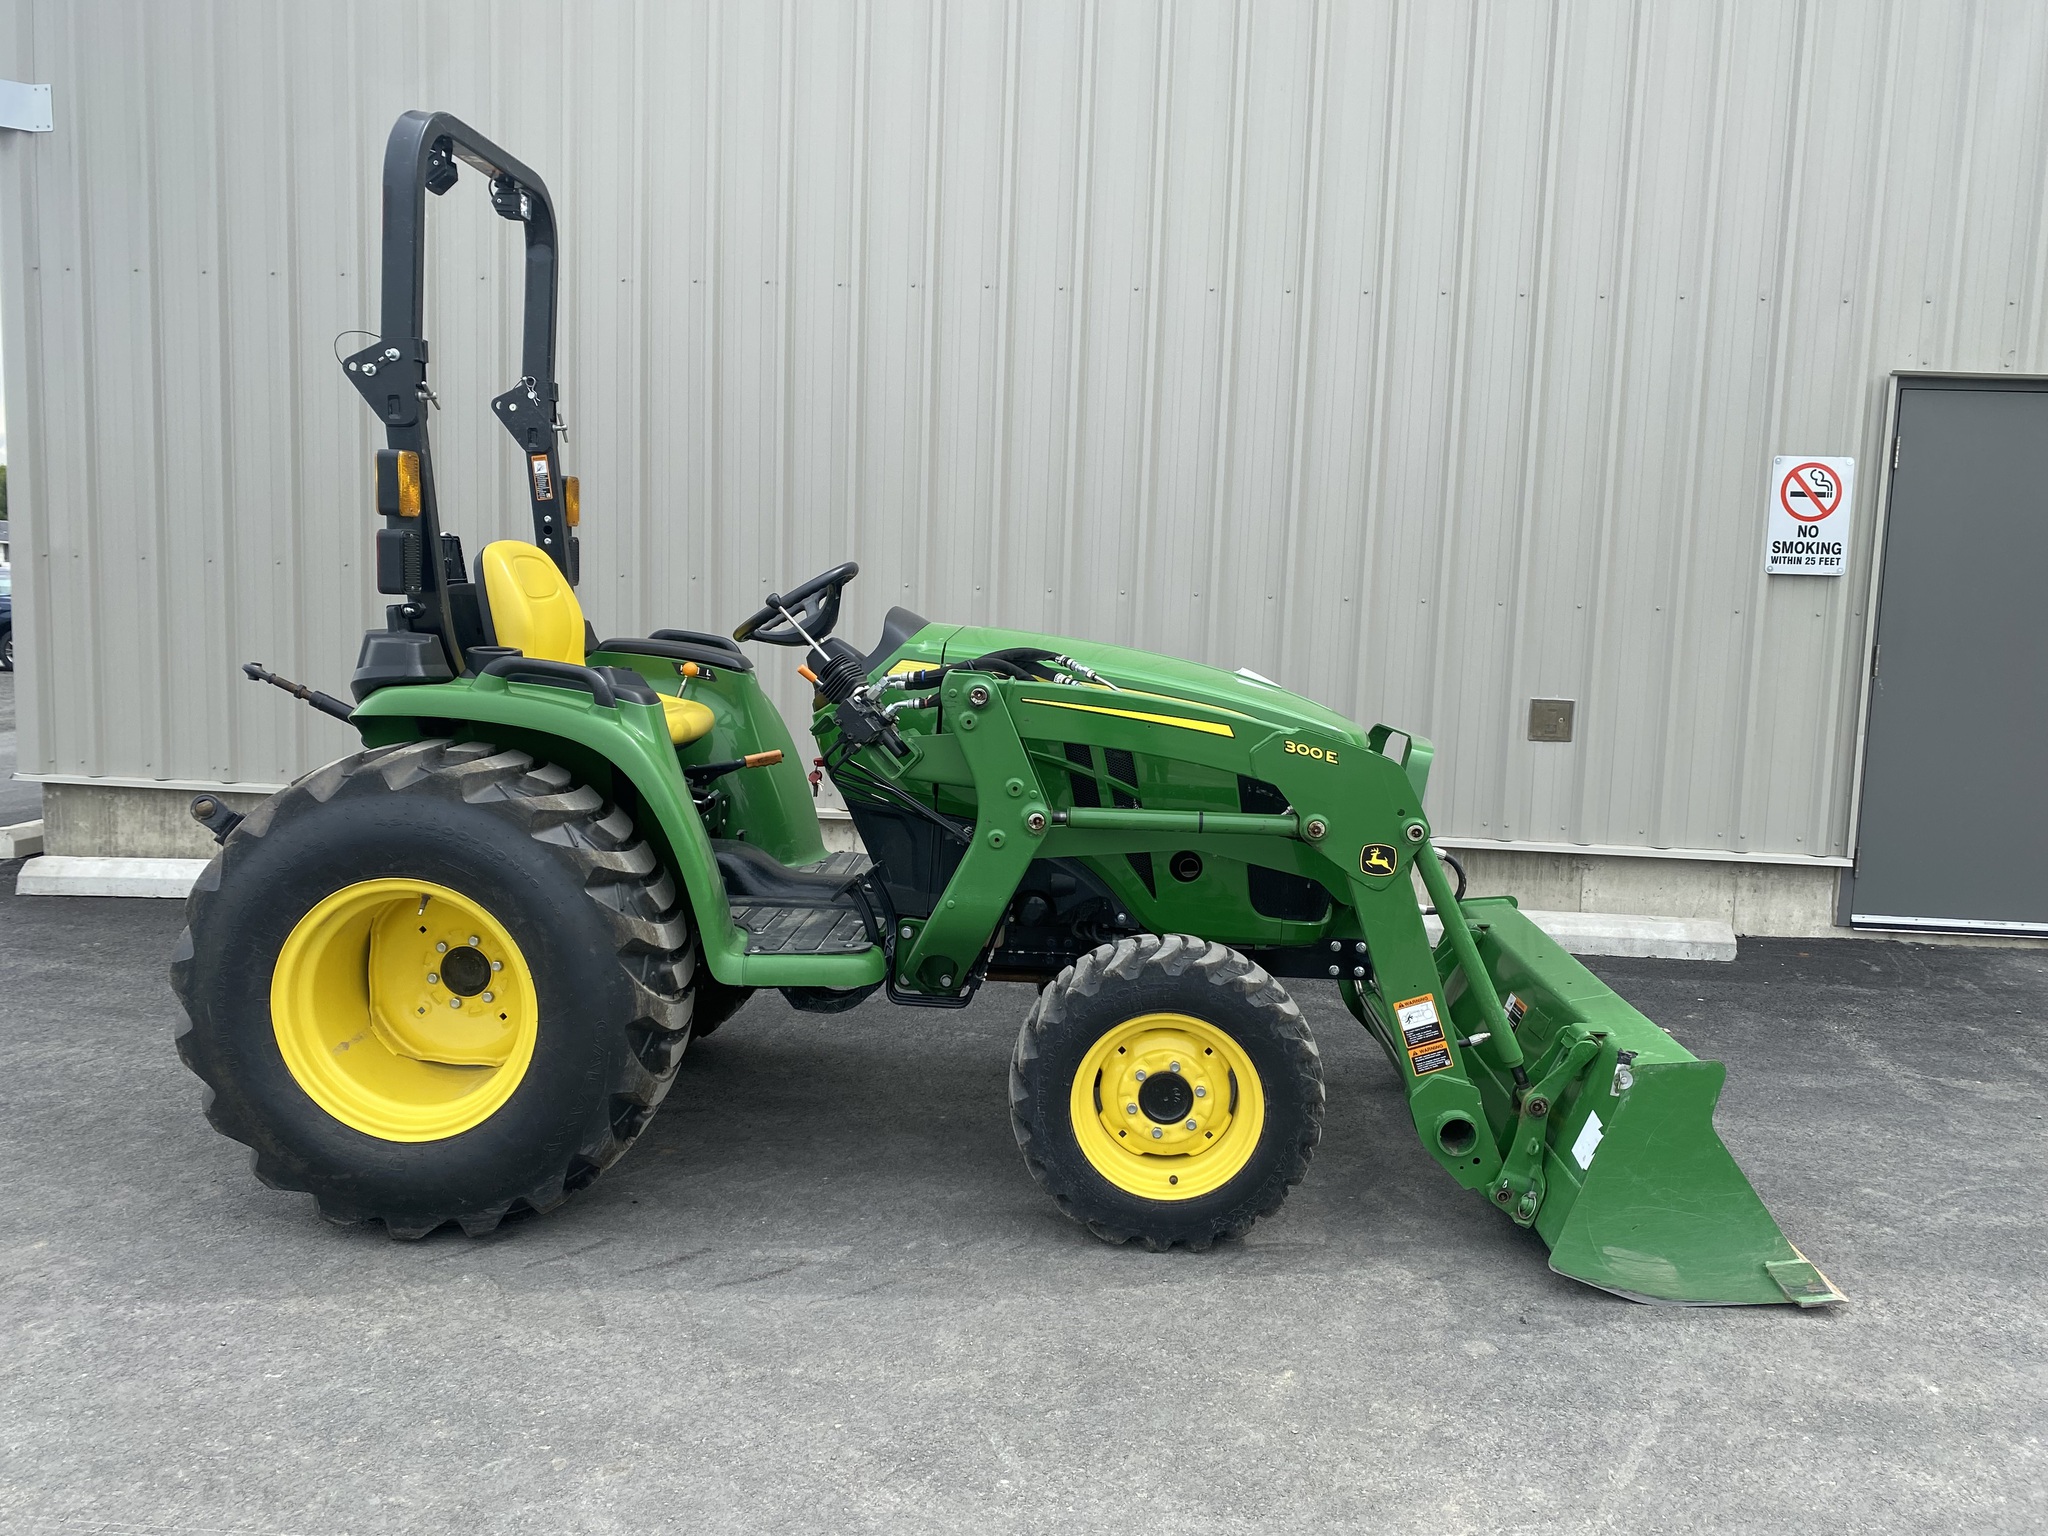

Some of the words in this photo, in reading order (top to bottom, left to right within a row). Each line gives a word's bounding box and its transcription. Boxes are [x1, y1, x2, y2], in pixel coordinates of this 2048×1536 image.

[1797, 525, 1819, 538] NO
[1772, 541, 1842, 555] SMOKING
[1770, 556, 1802, 565] WITHIN
[1805, 557, 1816, 565] 25
[1819, 557, 1841, 566] FEET
[1404, 995, 1429, 1007] WARNING
[1419, 1044, 1444, 1054] WARNING
